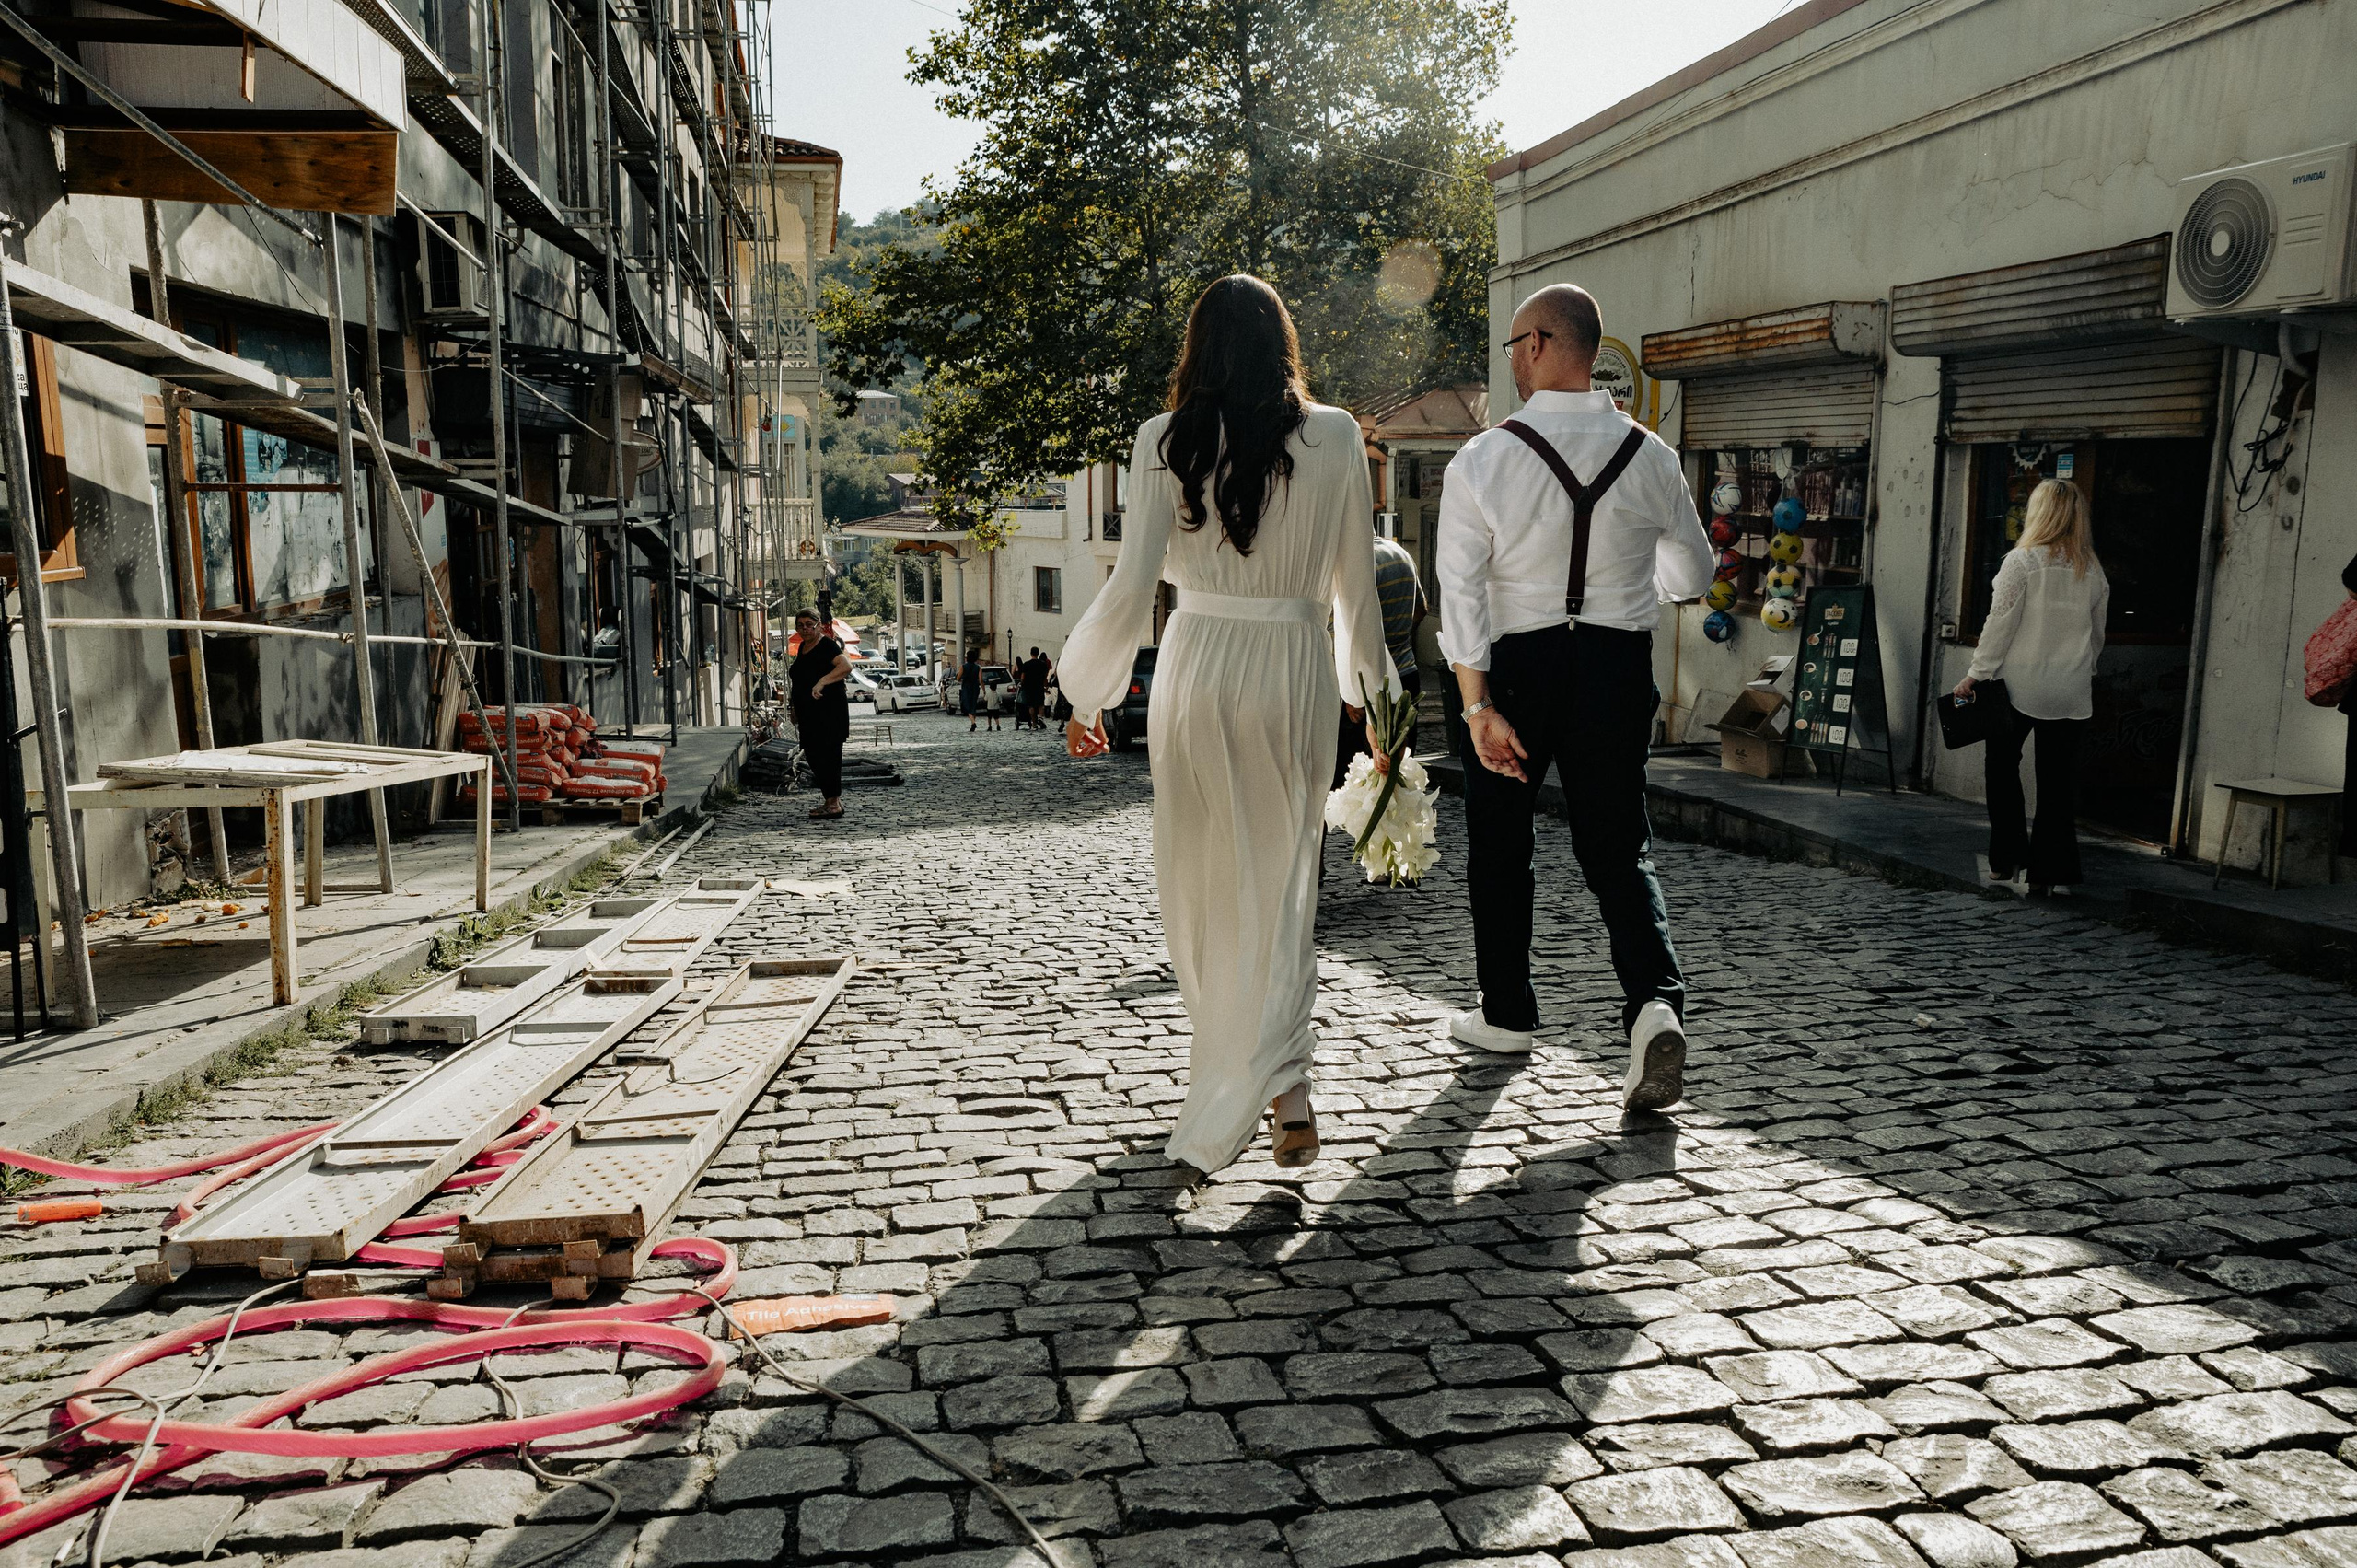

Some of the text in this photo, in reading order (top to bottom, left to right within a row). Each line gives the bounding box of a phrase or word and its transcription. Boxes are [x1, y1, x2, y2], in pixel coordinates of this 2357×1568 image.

[2293, 170, 2326, 184] HYUNDAI
[748, 1303, 872, 1321] Tile Adhesive
